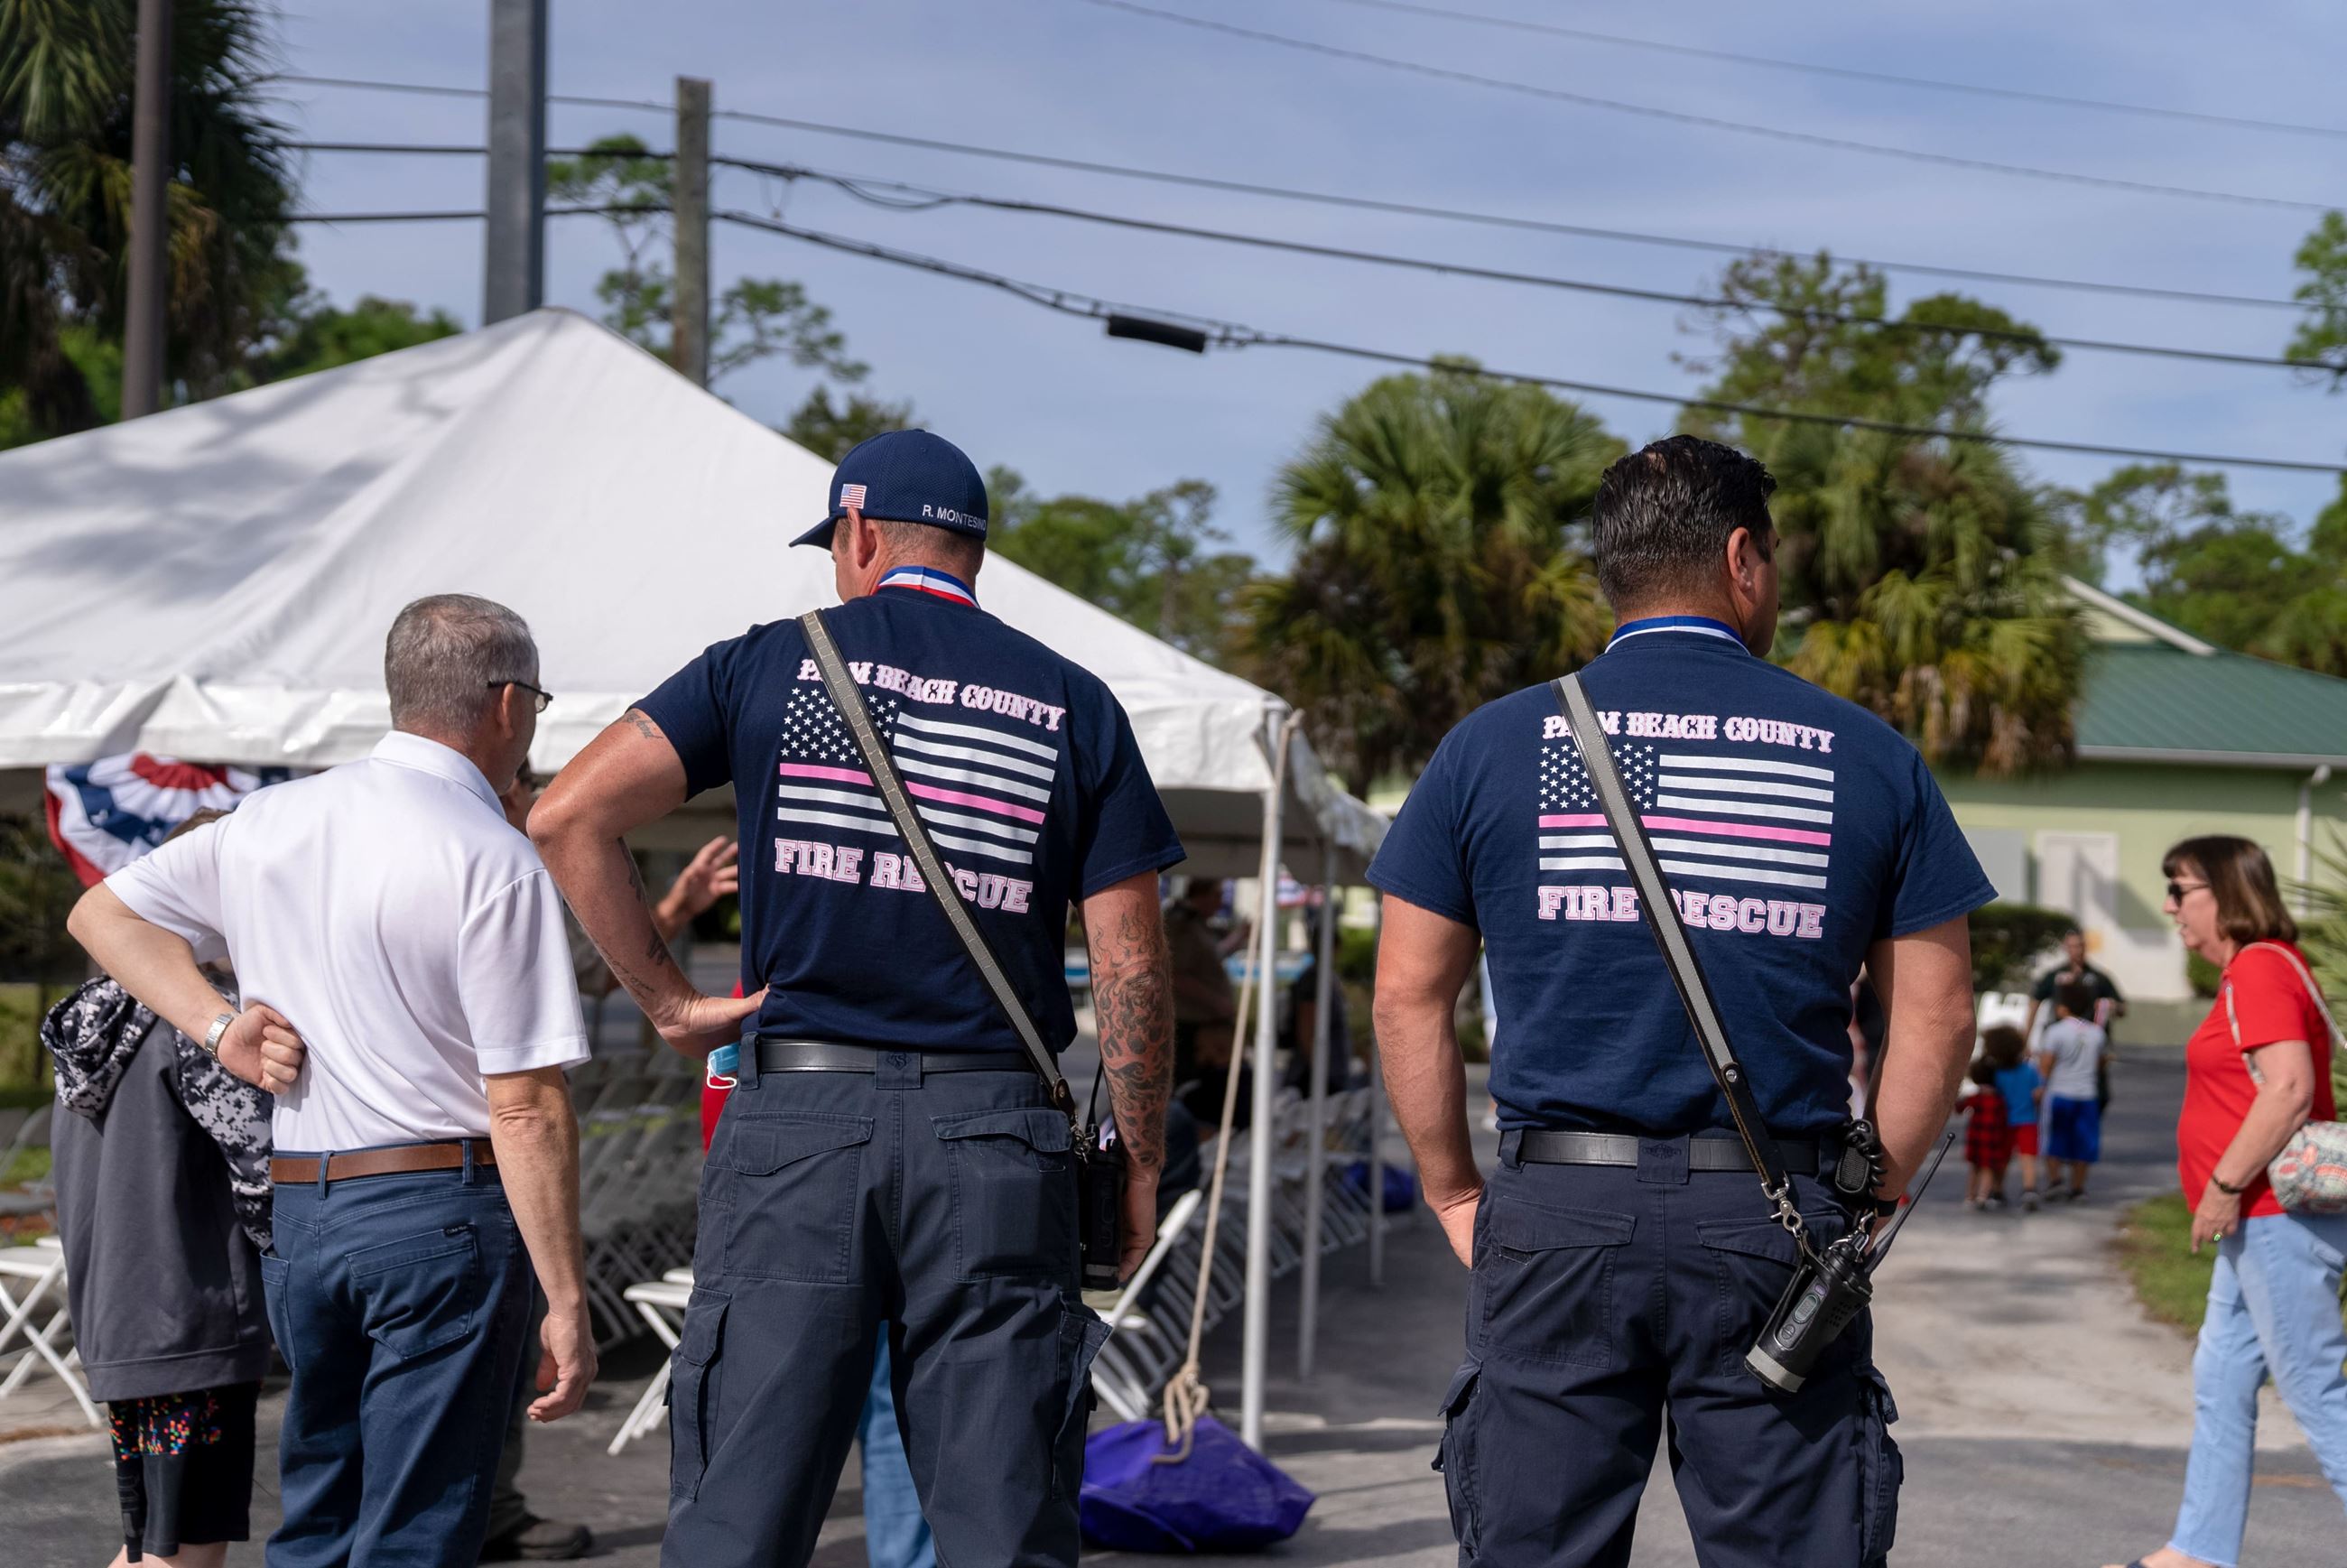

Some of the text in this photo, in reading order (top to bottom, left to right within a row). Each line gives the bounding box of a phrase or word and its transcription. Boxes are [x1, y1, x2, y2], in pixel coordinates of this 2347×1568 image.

[922, 504, 933, 517] R.
[797, 658, 1066, 732] PM BEACH COUNTY
[1625, 711, 1718, 740] BEACH
[1723, 716, 1835, 754] COUNTY
[775, 838, 1034, 914] FIRE RECUE
[1538, 886, 1639, 922] FIRE
